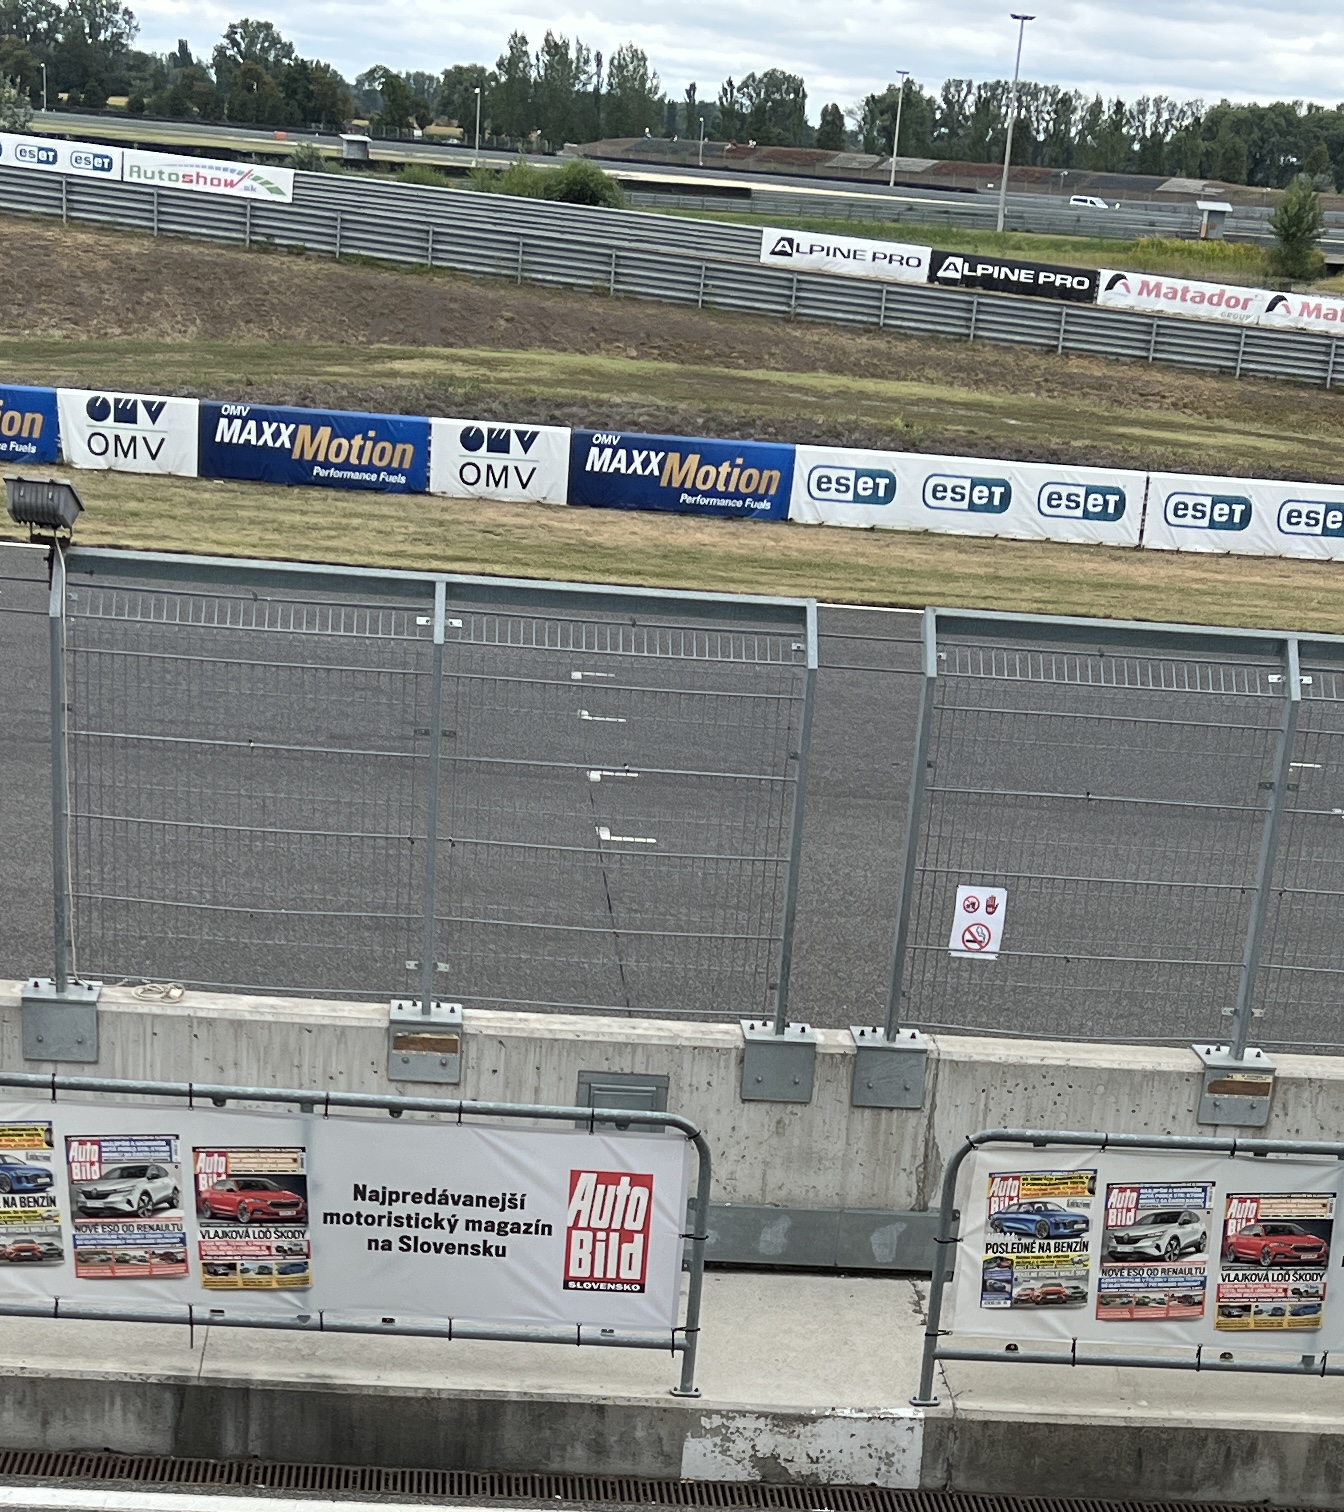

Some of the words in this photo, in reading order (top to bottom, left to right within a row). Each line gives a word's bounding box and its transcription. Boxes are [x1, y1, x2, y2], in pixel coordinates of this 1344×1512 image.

[129, 165, 235, 188] Autoshow
[770, 237, 866, 262] ALPINE
[872, 252, 922, 268] PRO
[937, 256, 1034, 282] ALPINE
[1038, 272, 1090, 289] PRO
[1138, 280, 1252, 310] Matador
[1220, 311, 1252, 320] GROUP
[88, 432, 165, 461] OMV
[313, 466, 377, 481] Performance
[459, 462, 536, 489] OMV
[679, 493, 743, 507] Performance
[70, 1141, 99, 1162] Auto
[197, 1153, 226, 1173] Auto
[353, 1183, 527, 1211] Najpredávanejší
[990, 1178, 1019, 1197] Auto
[1108, 1189, 1137, 1208] Auto
[3, 1196, 17, 1208] NA
[568, 1172, 650, 1231] Auto
[1227, 1199, 1257, 1218] Auto
[322, 1209, 459, 1235] motoristický
[465, 1216, 553, 1237] magazín
[367, 1236, 392, 1253] na
[398, 1235, 507, 1258] Slovensku
[569, 1230, 644, 1281] Bild
[1038, 1242, 1051, 1253] NA
[568, 1280, 641, 1292] SLOVENSKO
